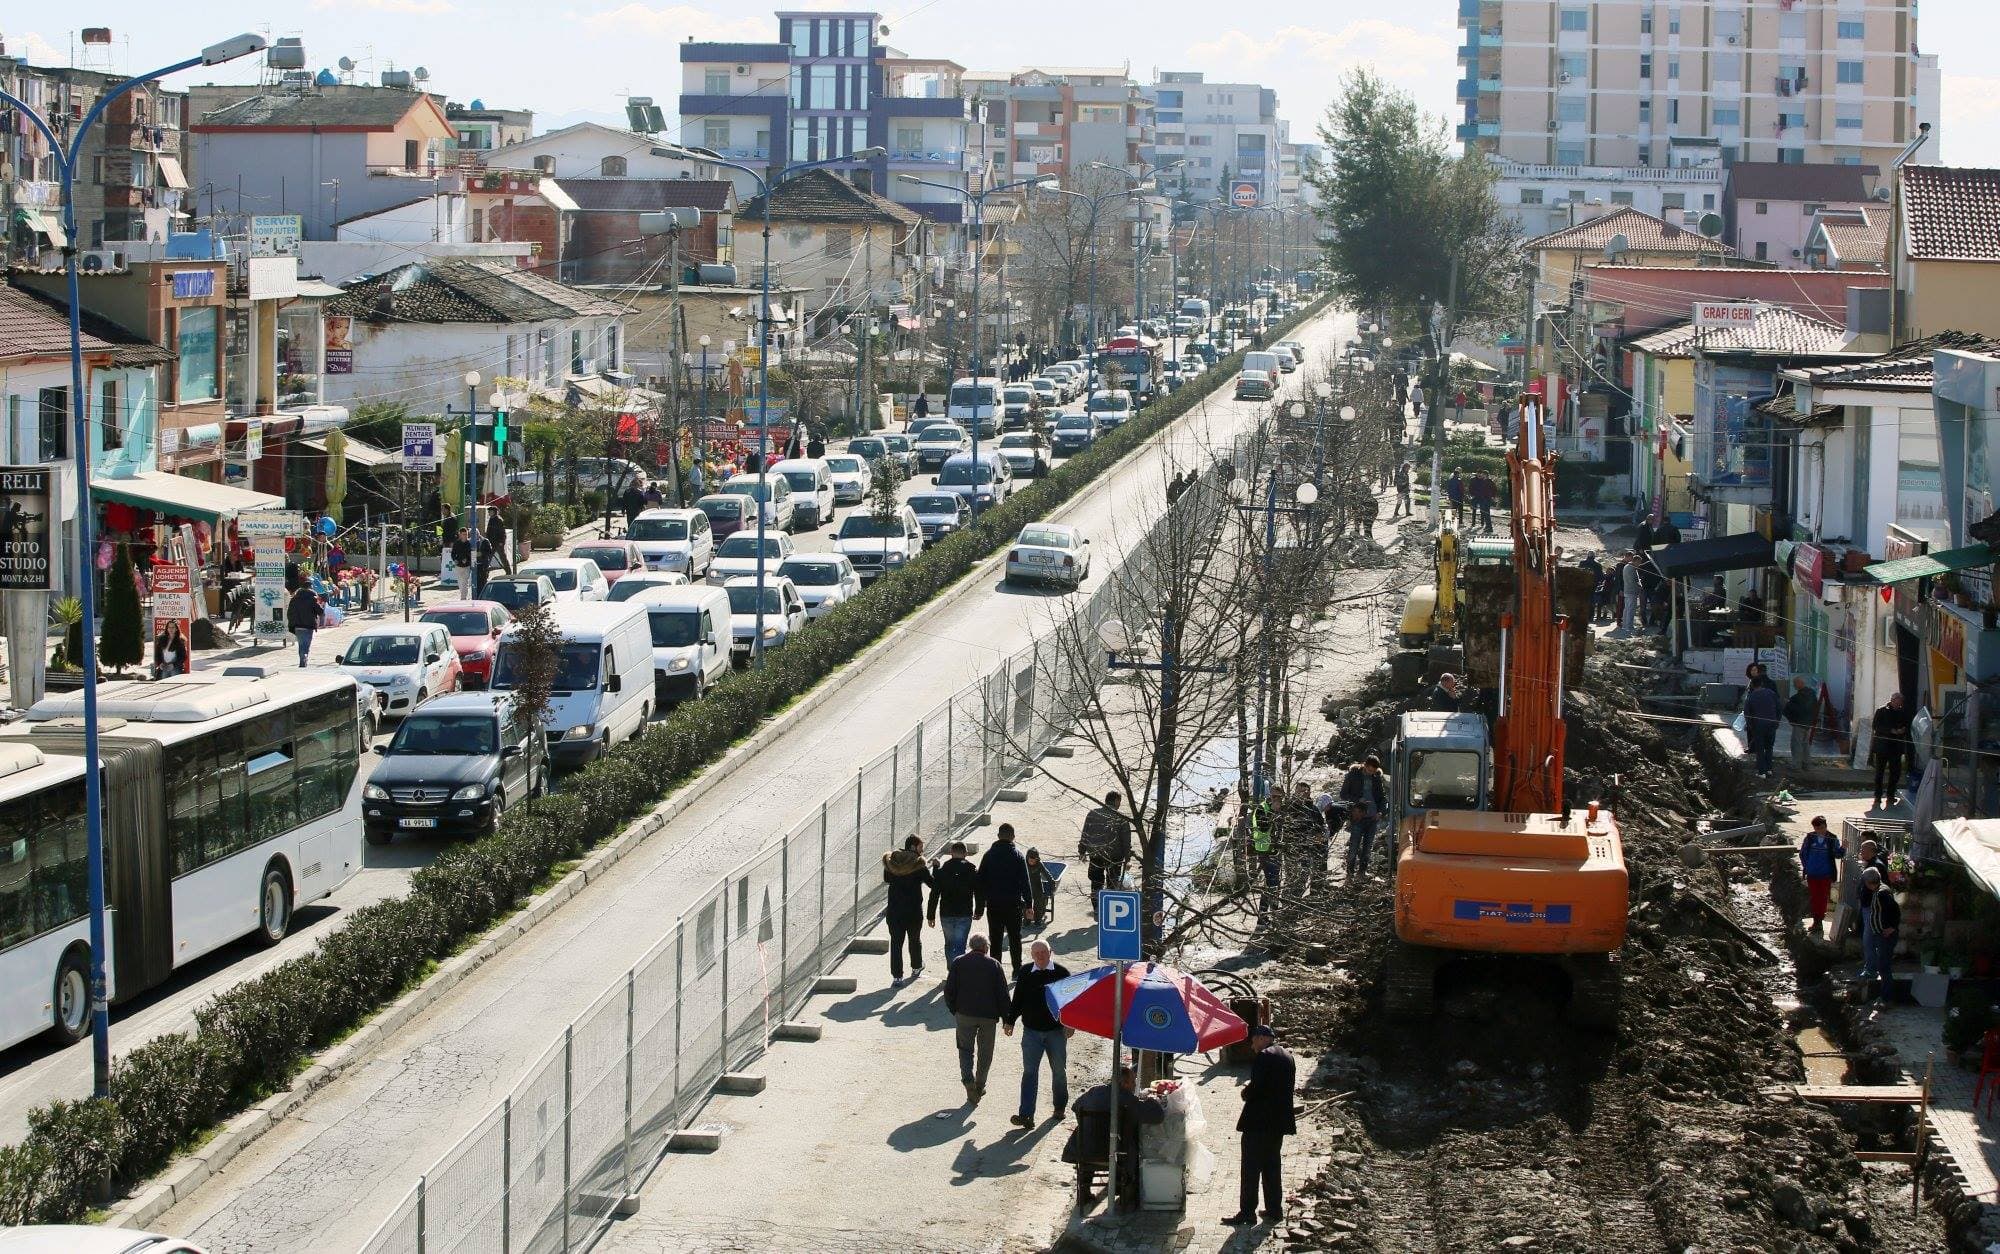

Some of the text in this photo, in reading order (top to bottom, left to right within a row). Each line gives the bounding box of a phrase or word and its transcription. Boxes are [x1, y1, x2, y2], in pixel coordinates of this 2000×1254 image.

[1233, 192, 1257, 200] Gulf
[255, 216, 297, 225] SERVIS
[255, 227, 298, 235] KOMPJUTERI
[1703, 306, 1752, 320] GRAFI GERI
[2, 474, 42, 490] RELI
[5, 541, 39, 554] FOTO
[0, 558, 47, 570] STUDIO
[2, 574, 45, 583] MONTAZHI
[1108, 900, 1130, 927] P
